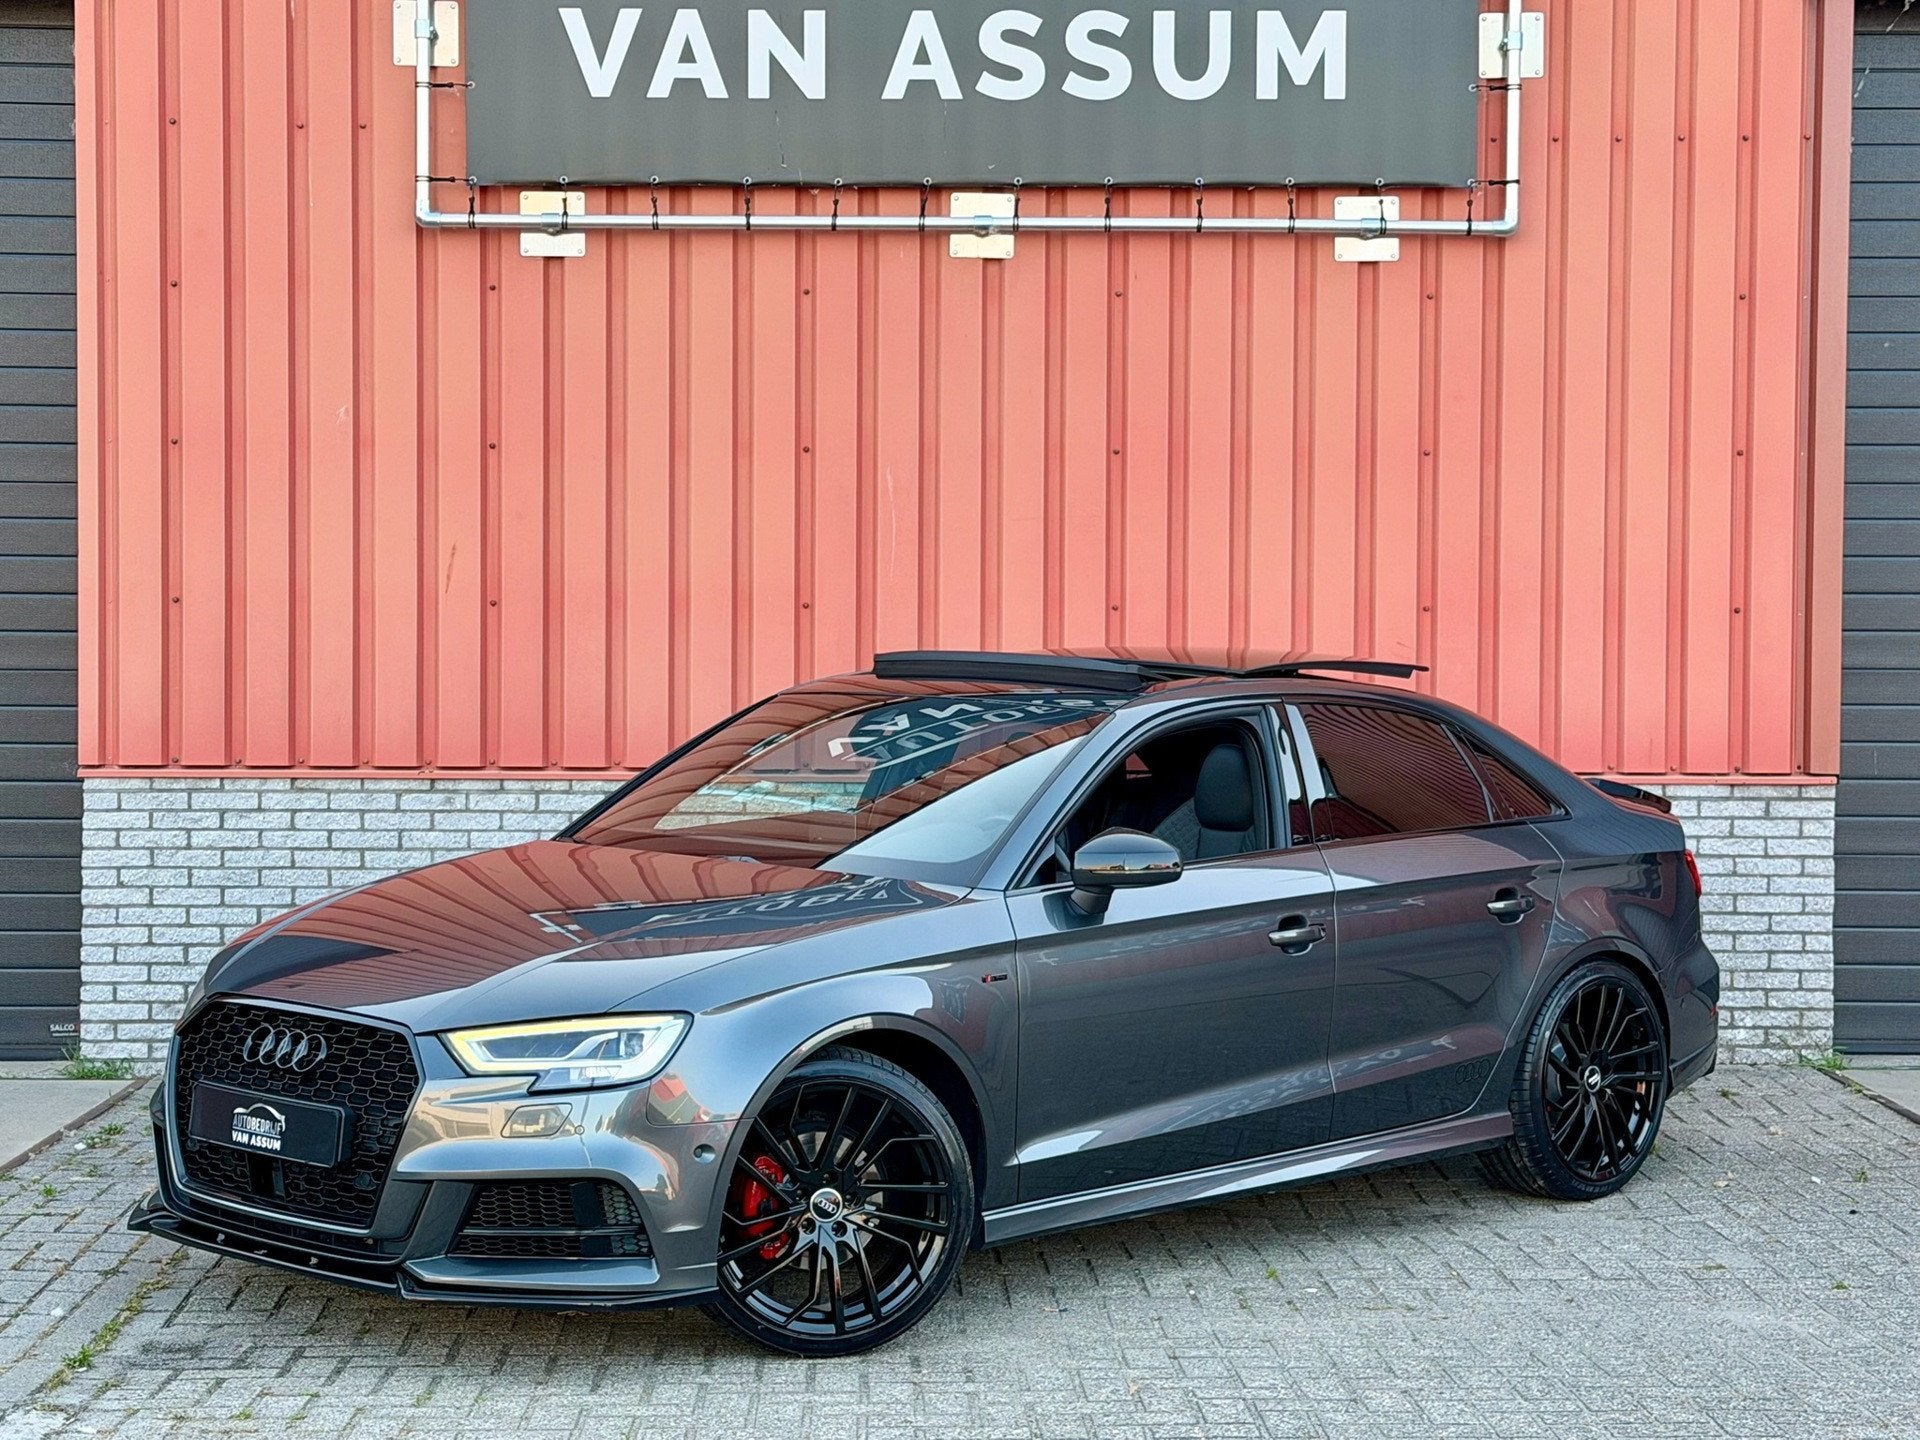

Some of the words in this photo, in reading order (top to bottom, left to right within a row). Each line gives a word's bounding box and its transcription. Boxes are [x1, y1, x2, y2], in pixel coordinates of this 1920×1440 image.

[557, 8, 826, 100] VAN
[881, 9, 1348, 101] ASSUM
[49, 1023, 75, 1032] SALCO
[232, 1114, 282, 1135] AUTOBEDRIJF
[231, 1130, 249, 1145] VAN
[250, 1135, 282, 1151] ASSUM
